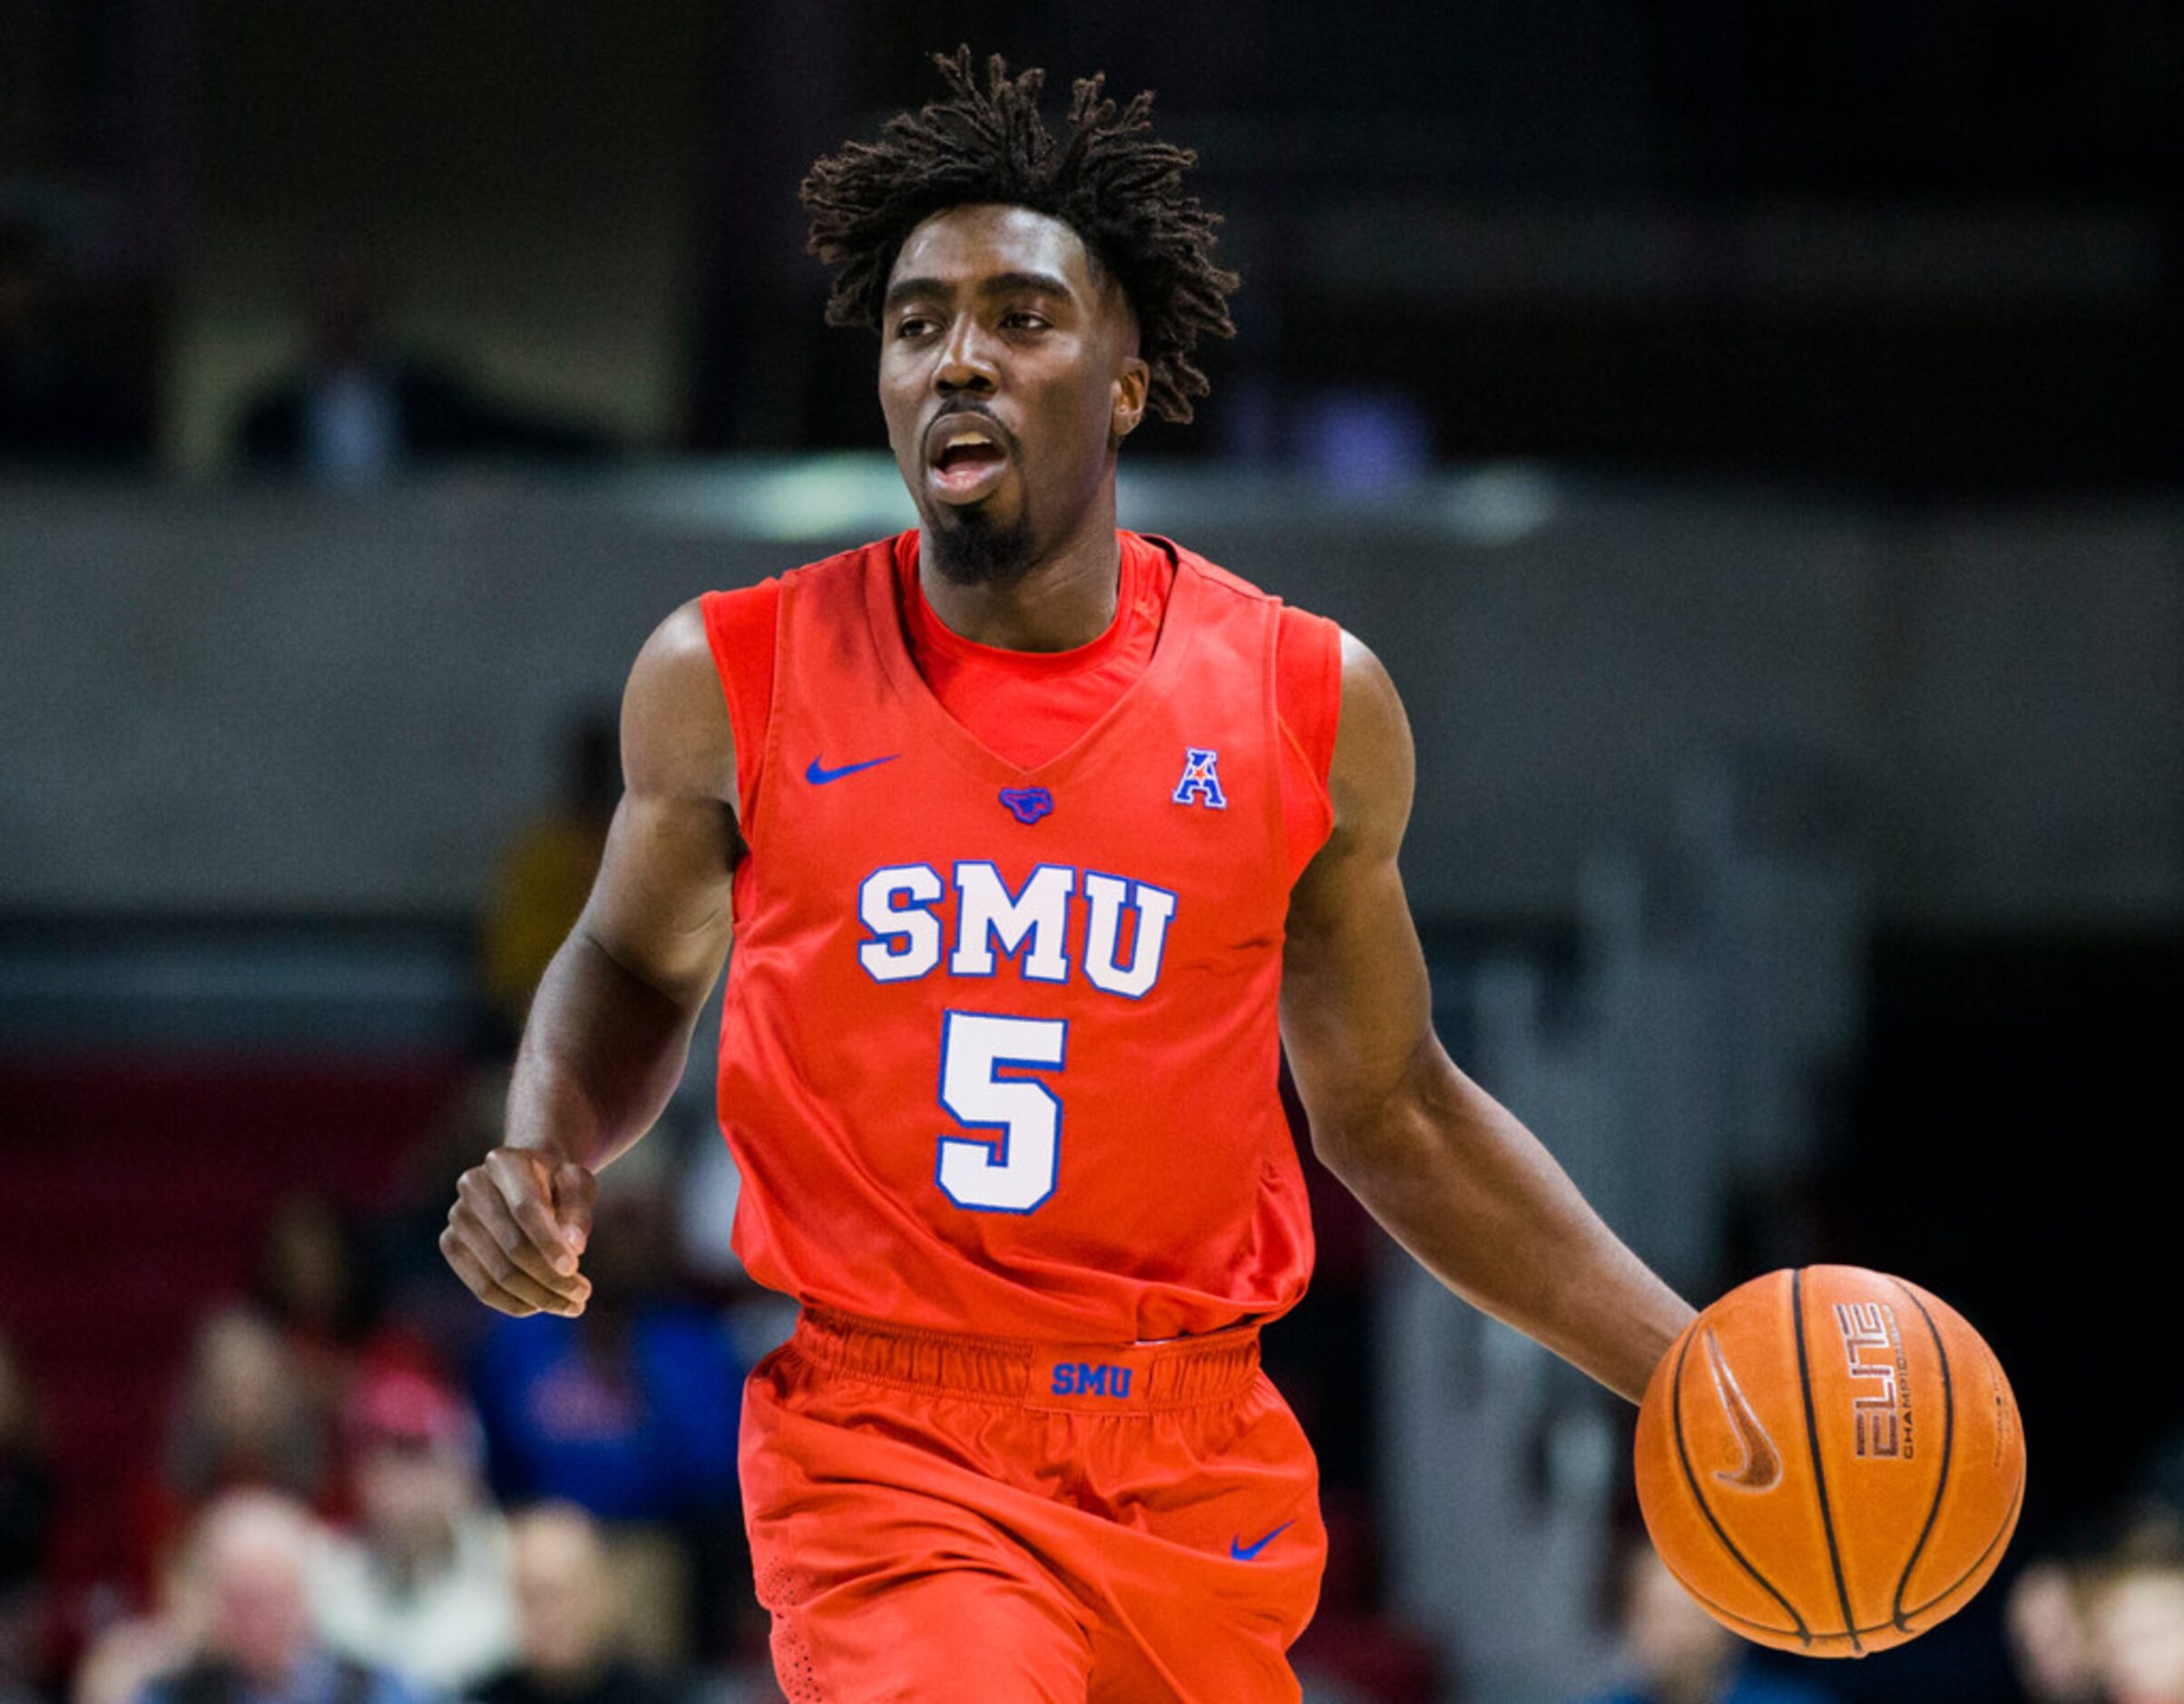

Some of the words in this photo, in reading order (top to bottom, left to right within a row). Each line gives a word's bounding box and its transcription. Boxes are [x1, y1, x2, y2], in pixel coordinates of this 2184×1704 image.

[1173, 748, 1227, 808] A
[857, 860, 1178, 1000] SMU
[935, 1009, 1069, 1215] 5
[1051, 1363, 1133, 1399] SMU
[1834, 1301, 1898, 1459] ELITE
